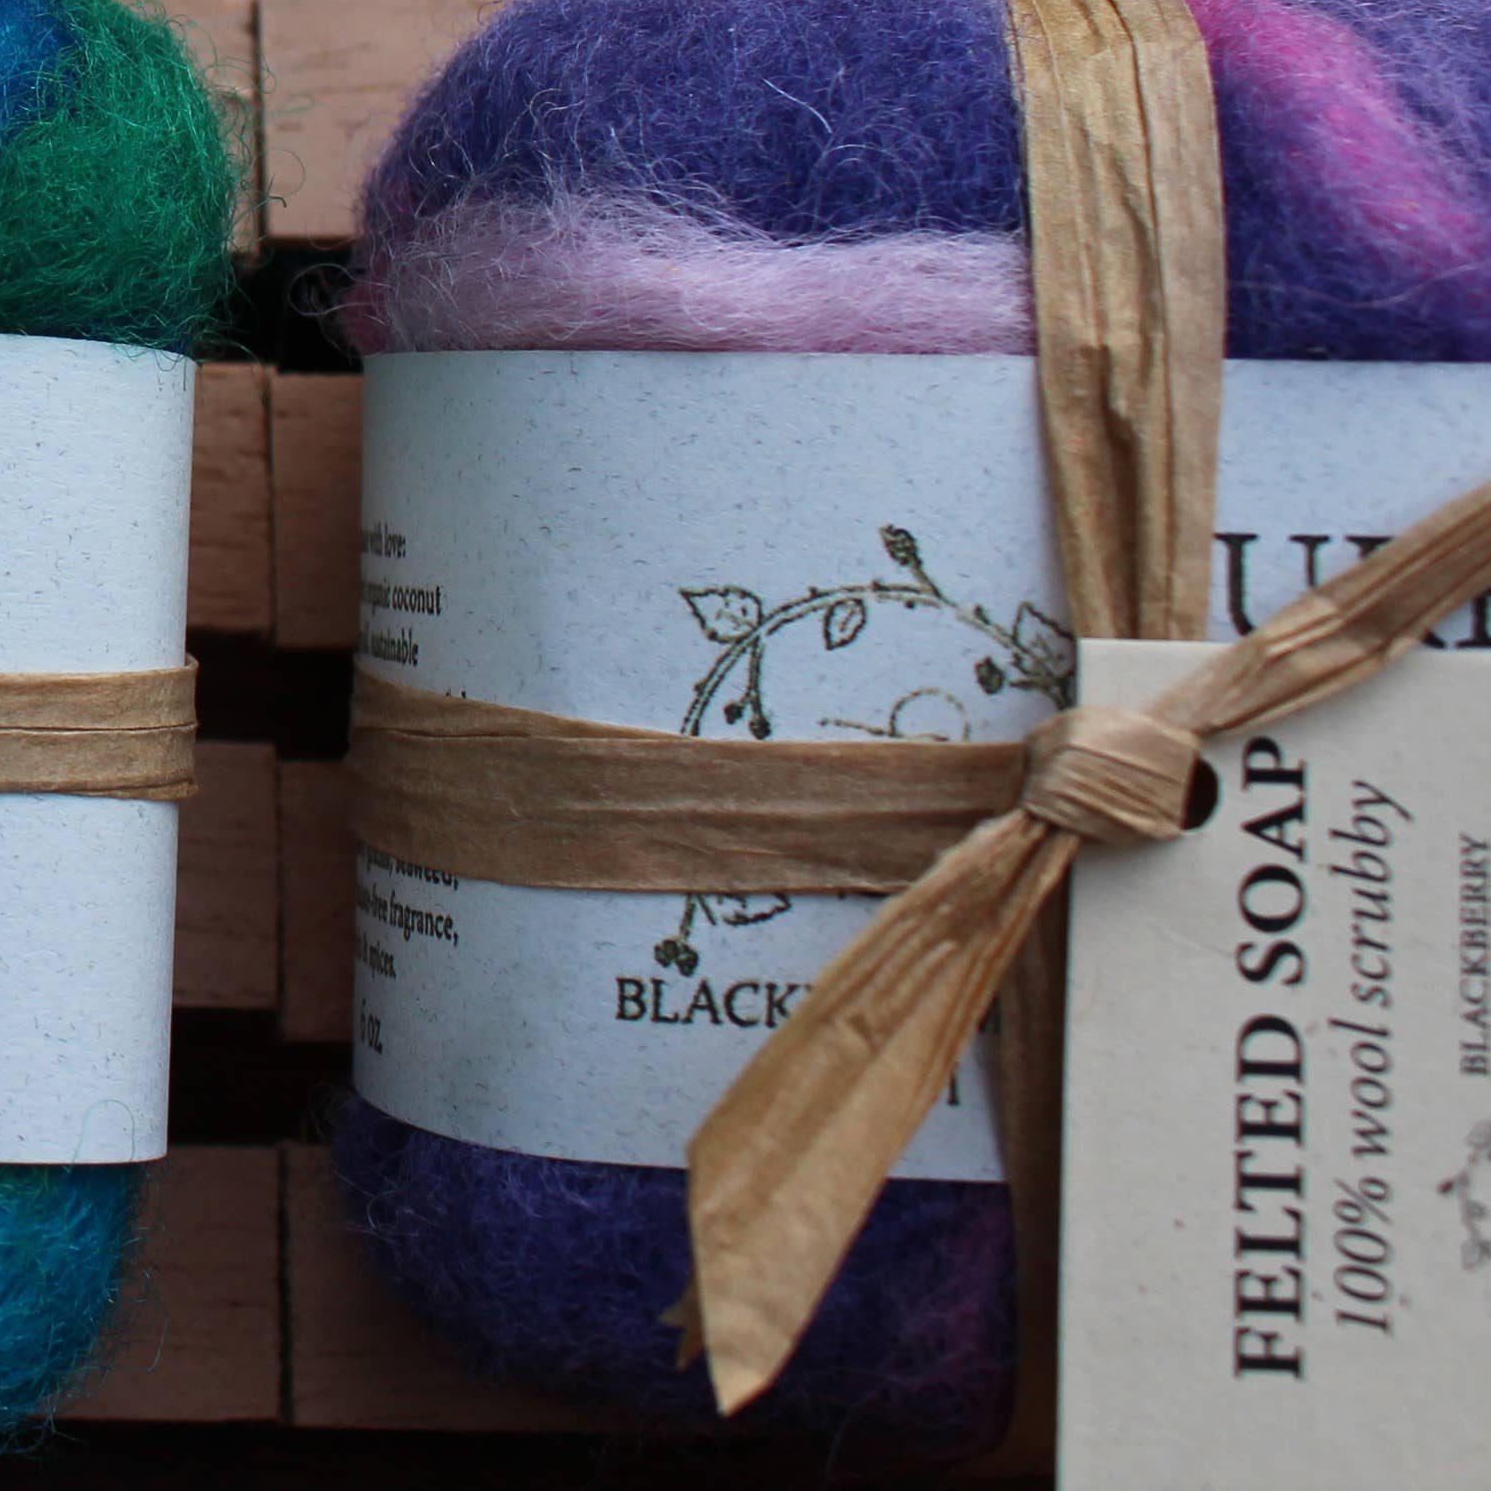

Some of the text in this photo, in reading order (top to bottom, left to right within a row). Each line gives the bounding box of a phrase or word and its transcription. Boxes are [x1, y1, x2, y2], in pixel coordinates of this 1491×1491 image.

[391, 584, 442, 616] coconut
[389, 890, 459, 947] fragrance,
[1458, 832, 1491, 1078] BLACKBERRY
[615, 976, 809, 1029] BLACK
[1232, 735, 1309, 1380] FELTED SOAP
[1329, 779, 1413, 1336] 100% wool scrubby
